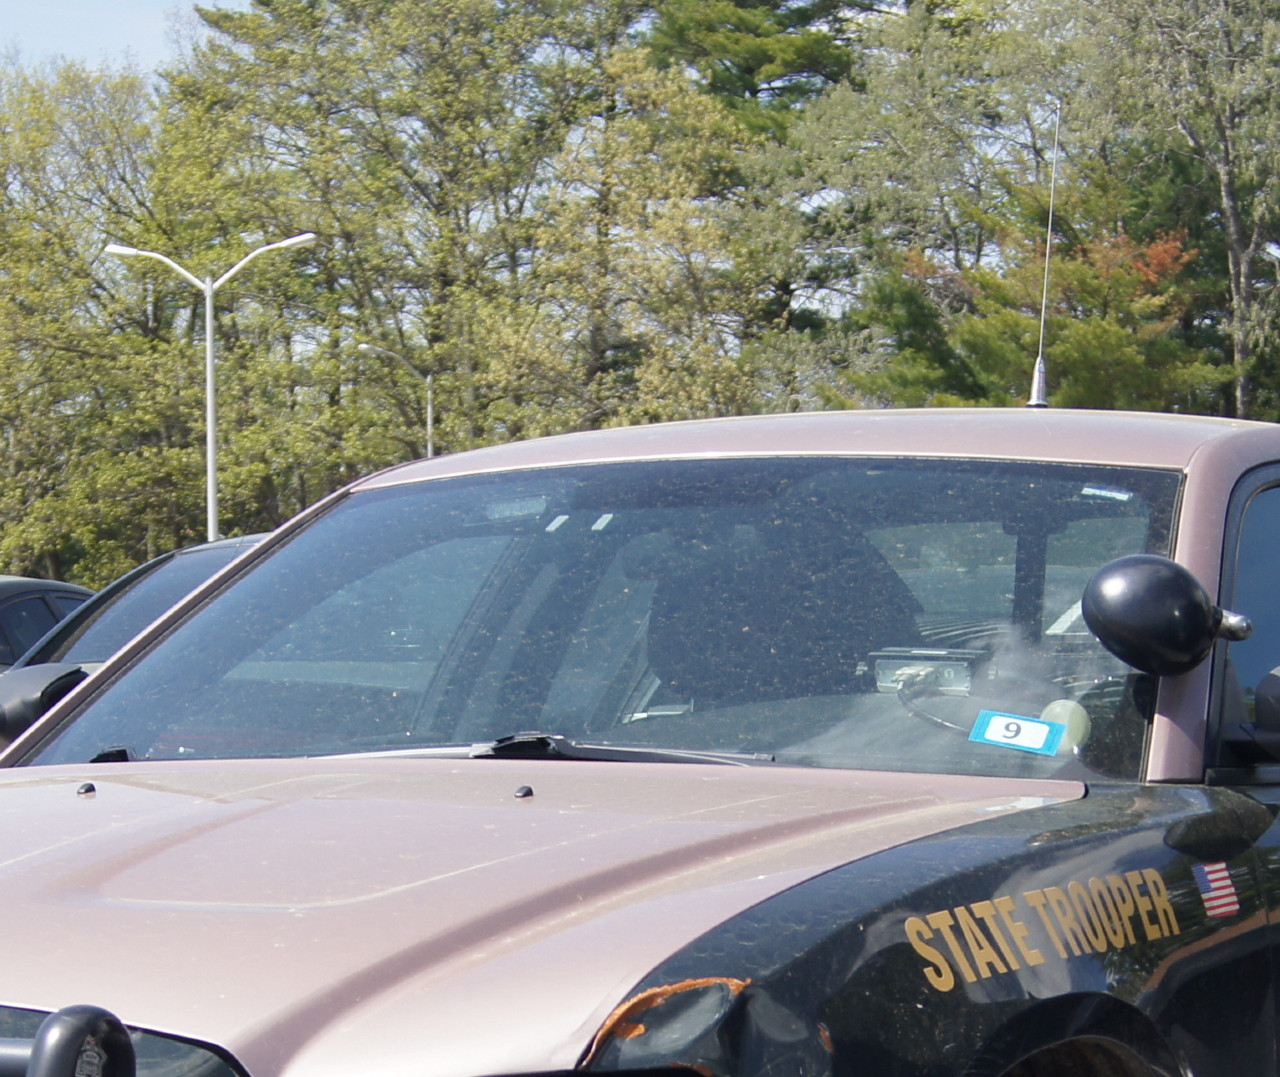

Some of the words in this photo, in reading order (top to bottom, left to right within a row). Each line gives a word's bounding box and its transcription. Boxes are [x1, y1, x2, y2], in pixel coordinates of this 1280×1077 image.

[1002, 721, 1022, 740] 9
[905, 895, 1045, 992] STATE
[1023, 867, 1180, 960] TROOPER
